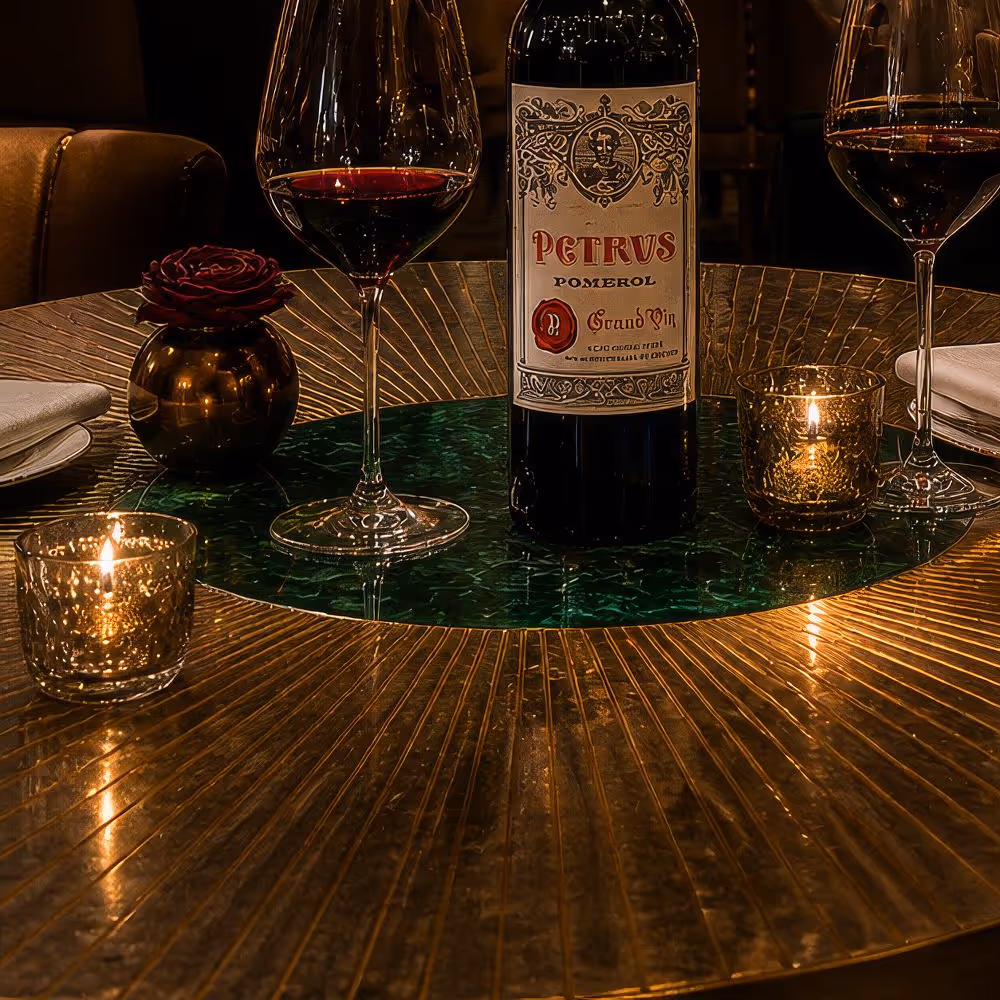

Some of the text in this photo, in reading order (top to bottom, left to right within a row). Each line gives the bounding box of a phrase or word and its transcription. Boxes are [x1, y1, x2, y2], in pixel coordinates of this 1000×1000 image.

[553, 275, 657, 288] POMEROL
[586, 307, 676, 335] Grand Vin
